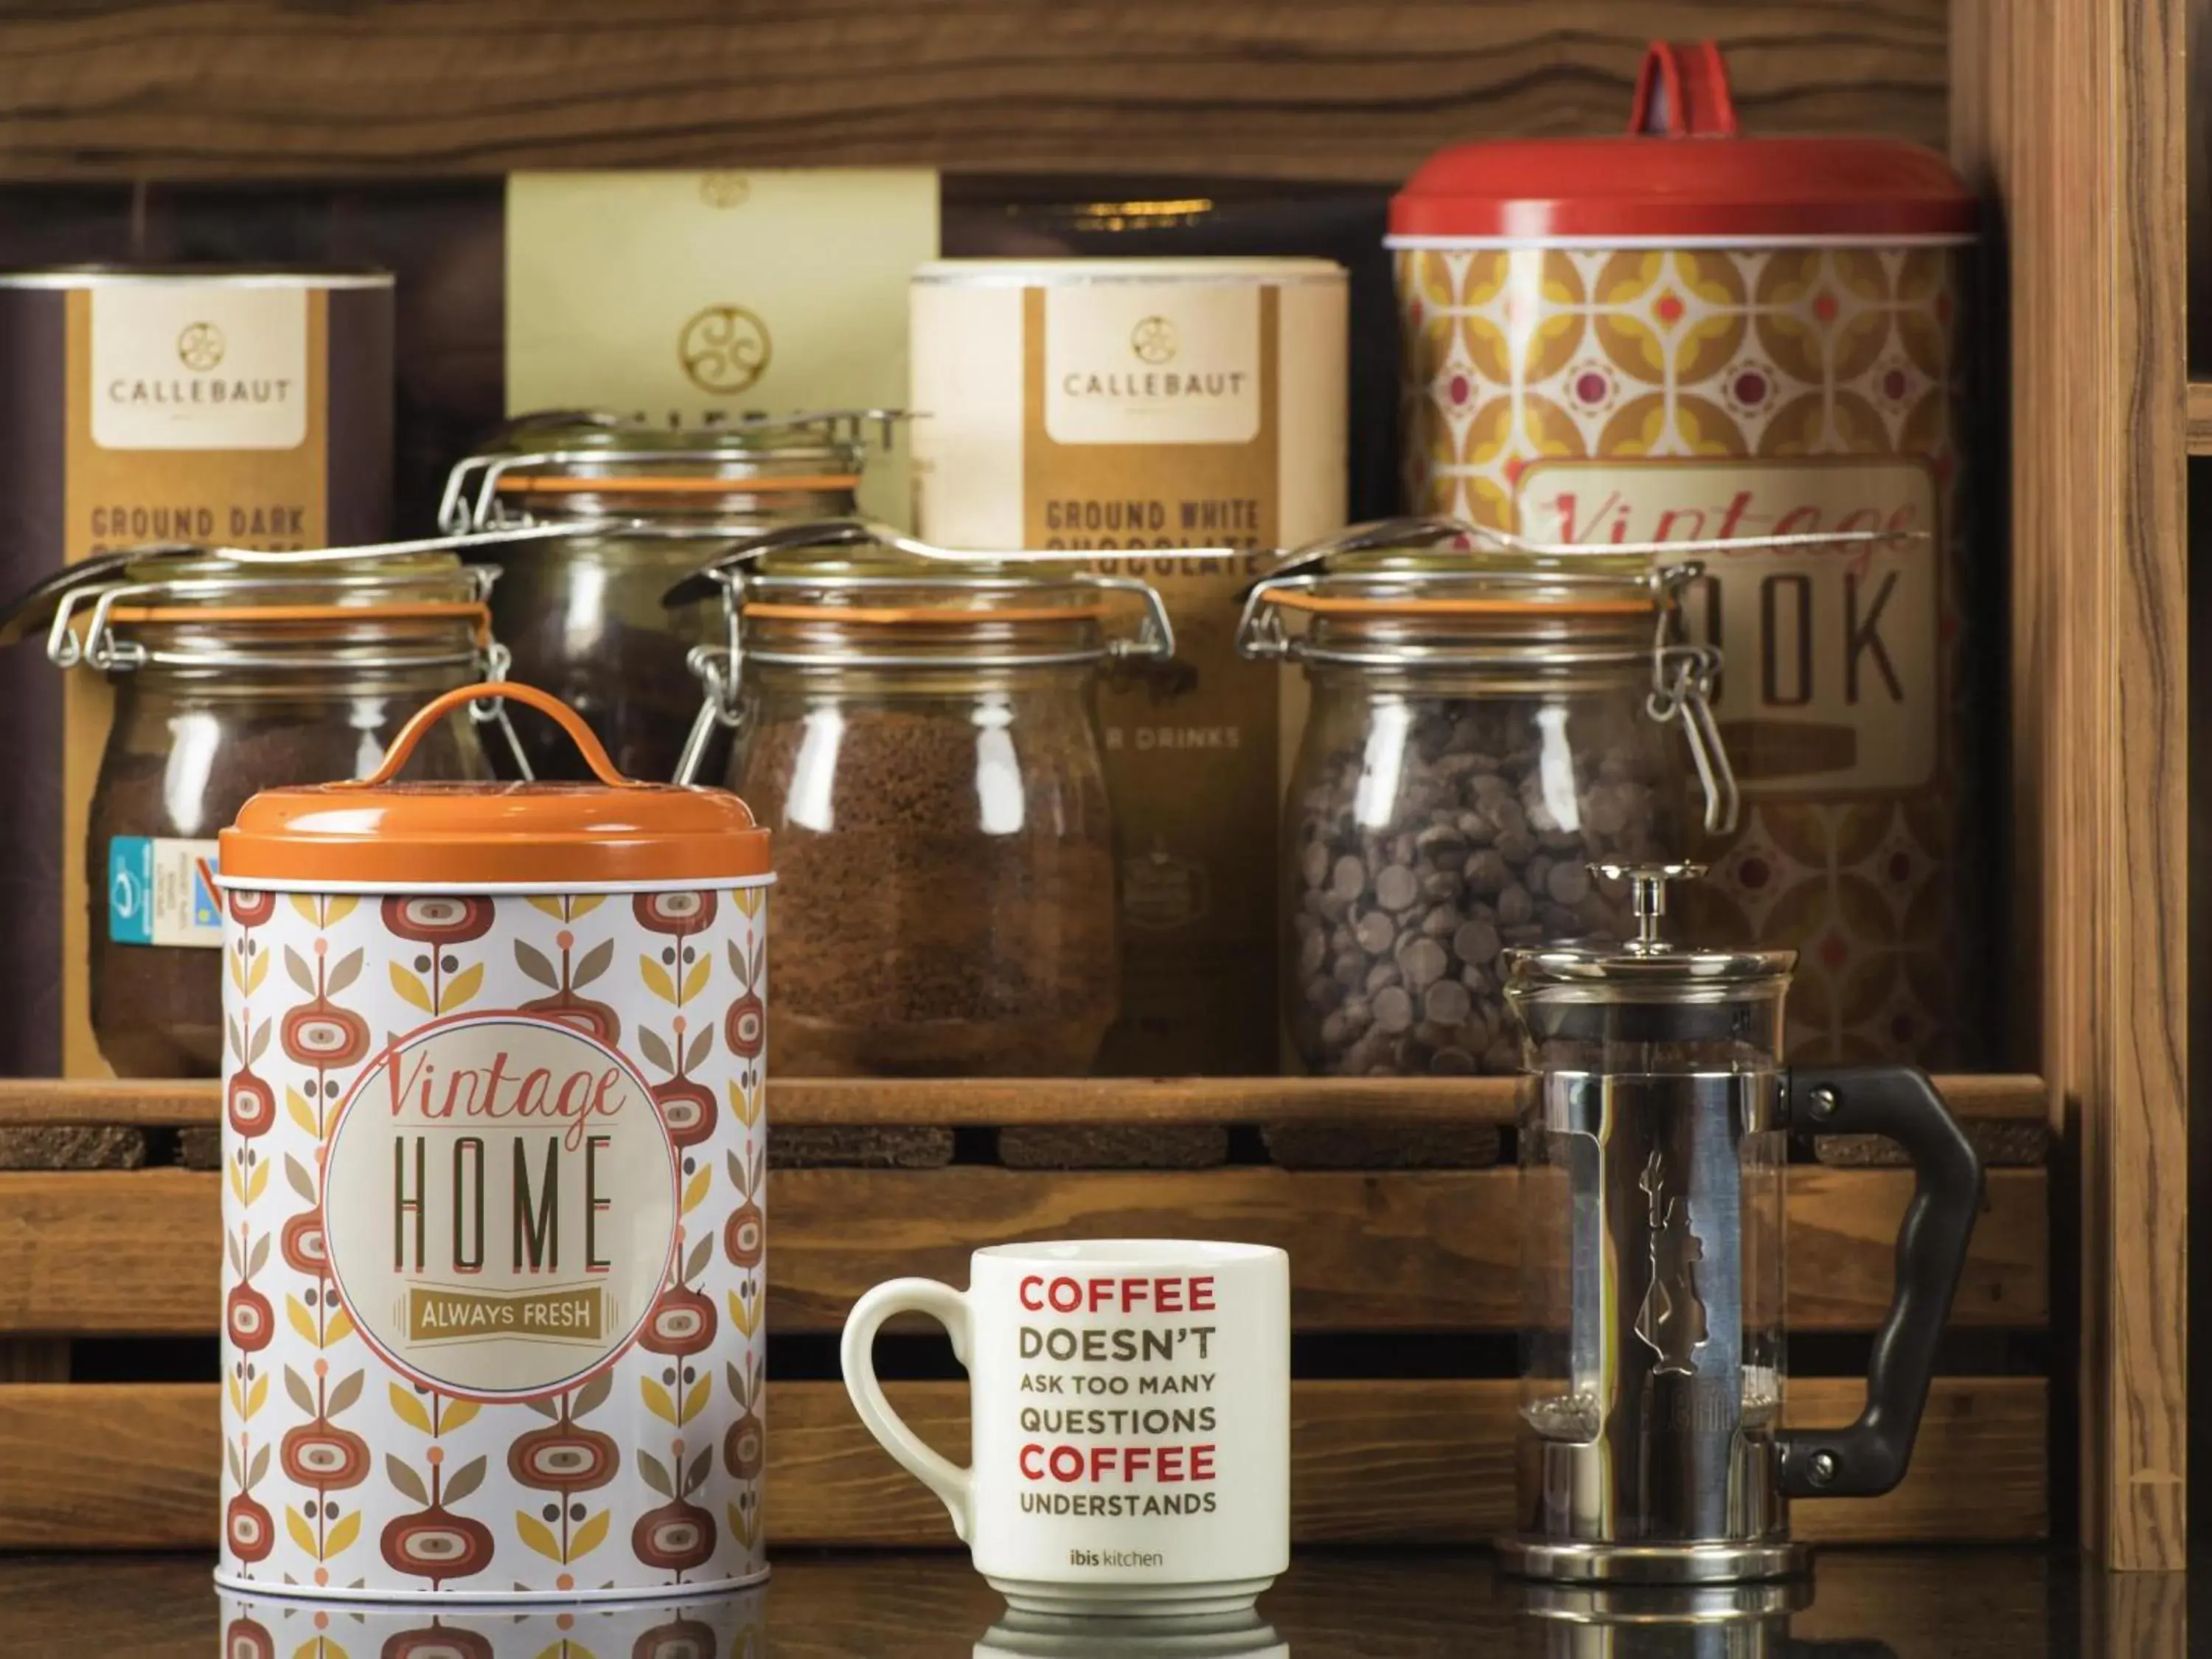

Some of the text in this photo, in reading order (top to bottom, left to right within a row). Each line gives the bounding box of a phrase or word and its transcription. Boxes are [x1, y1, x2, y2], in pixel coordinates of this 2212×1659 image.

[108, 378, 293, 405] CALLEBAUT
[1062, 371, 1246, 398] CALLEBAUT
[90, 504, 305, 538] GROUND DARK
[1046, 498, 1259, 532] GROUND WHITE
[1135, 726, 1240, 751] DRINKS
[378, 1049, 626, 1152] Vintage
[394, 1135, 611, 1275] HOME
[1019, 1275, 1217, 1313] COFFEE
[421, 1299, 591, 1328] ALWAYS FRESH
[1019, 1326, 1217, 1362] DOESN'T
[1020, 1372, 1217, 1395] ASK TOO MANY
[1020, 1406, 1217, 1435] QUESTIONS
[1019, 1443, 1217, 1484] COFFEE
[1020, 1492, 1217, 1517] UNDERSTANDS
[1070, 1549, 1164, 1568] ibis kitchen
